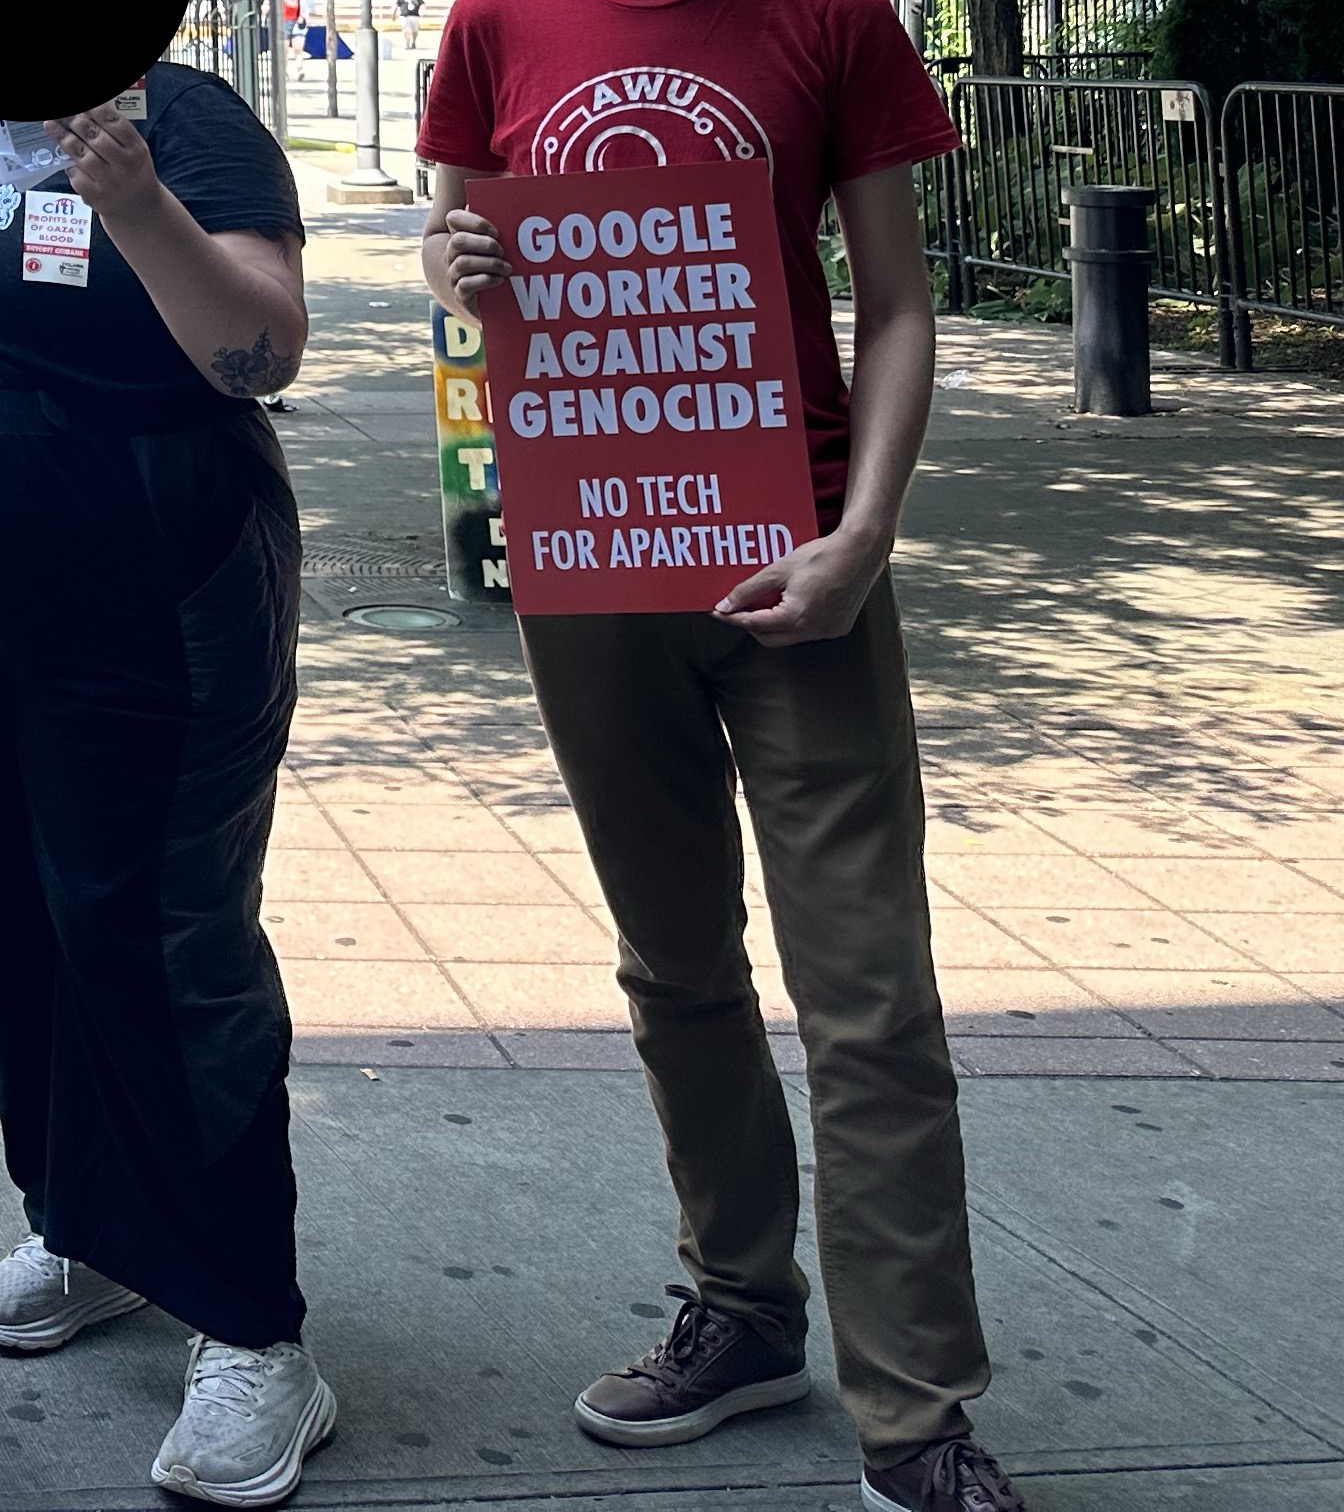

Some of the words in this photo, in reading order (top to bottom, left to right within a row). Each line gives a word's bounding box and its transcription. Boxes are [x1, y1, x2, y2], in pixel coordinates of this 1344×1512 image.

[592, 72, 699, 113] AWU
[517, 202, 737, 265] GOOGLE
[509, 262, 756, 321] WORKER
[524, 321, 757, 380] AGAINST
[508, 380, 788, 439] GENOCIDE
[579, 477, 628, 519] NO
[637, 474, 723, 517] TECH
[532, 530, 602, 572] FOR
[610, 524, 793, 569] APARTHEID
